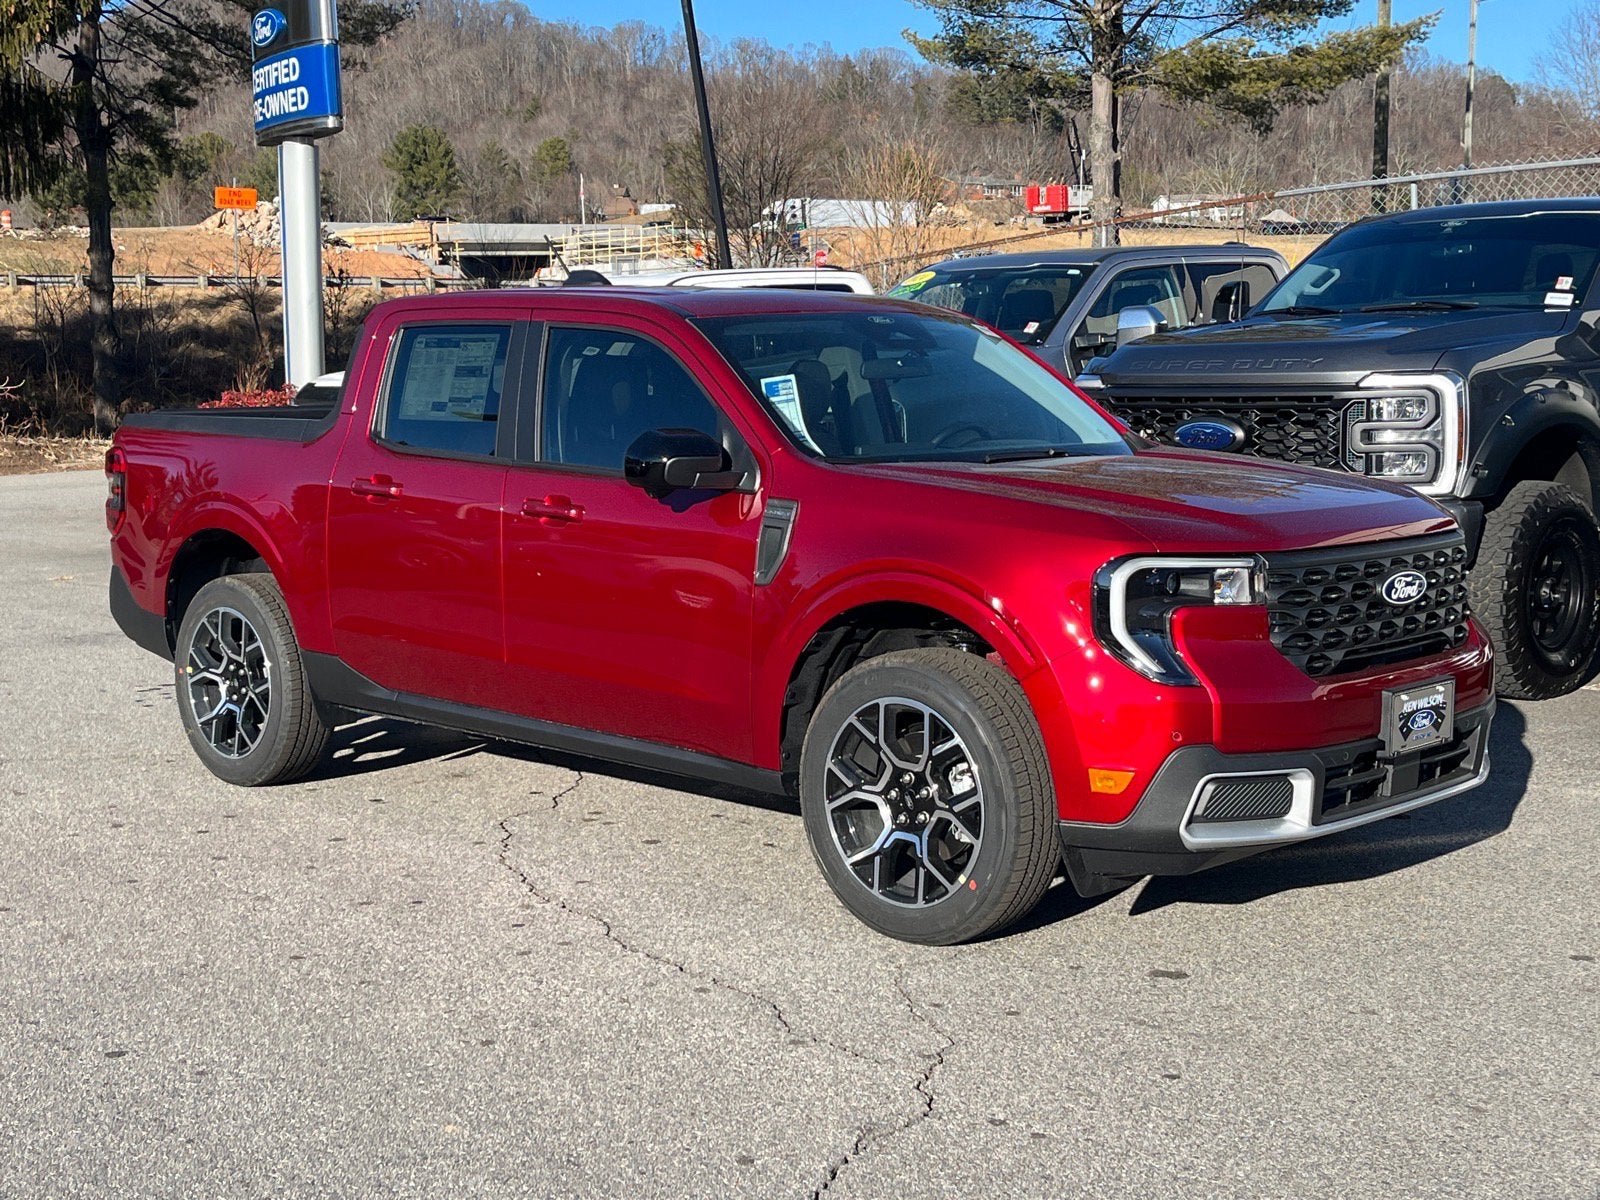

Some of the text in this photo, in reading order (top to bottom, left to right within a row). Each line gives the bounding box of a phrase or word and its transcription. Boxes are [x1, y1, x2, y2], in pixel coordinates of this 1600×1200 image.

[229, 190, 242, 198] END
[1129, 357, 1324, 371] SUPER DUTY
[1186, 427, 1222, 445] Ford
[1391, 576, 1419, 600] Ford
[1402, 693, 1444, 714] KEN WILSON
[1413, 712, 1432, 729] Ford
